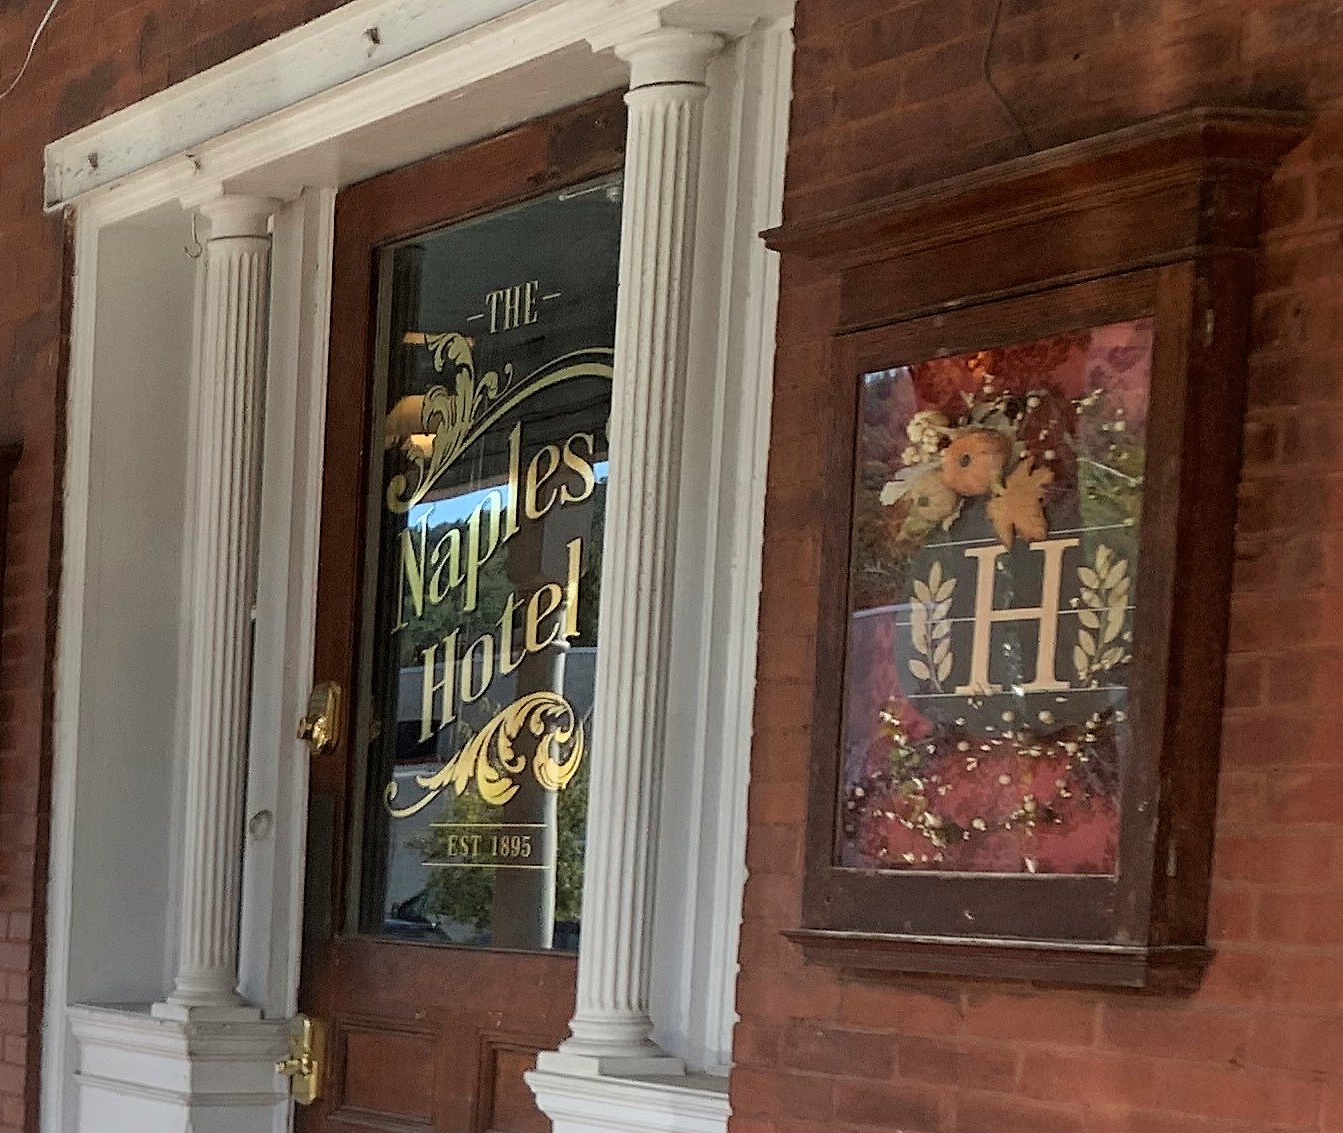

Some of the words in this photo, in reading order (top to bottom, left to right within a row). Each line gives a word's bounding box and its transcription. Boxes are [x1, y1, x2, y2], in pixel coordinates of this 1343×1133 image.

[485, 280, 539, 334] THE
[391, 420, 595, 635] Naples
[418, 538, 581, 744] Hotel
[955, 538, 1080, 696] H
[447, 835, 482, 857] EST
[492, 835, 532, 858] 1895
